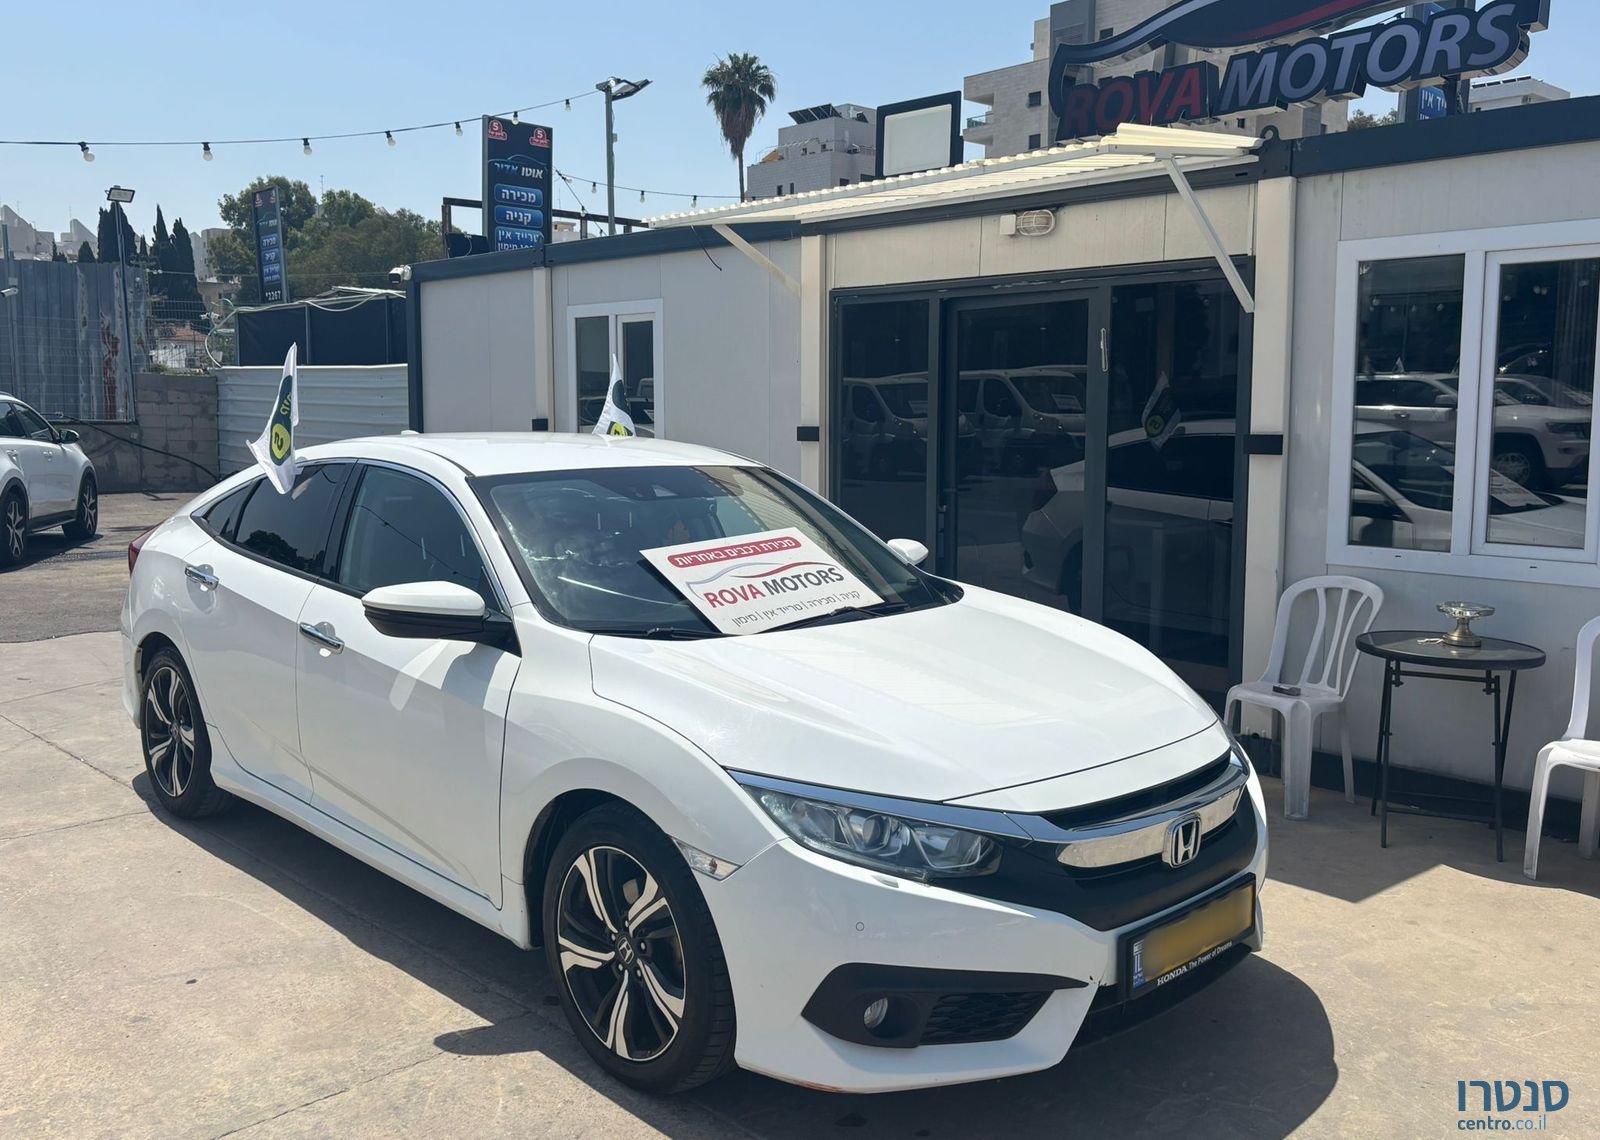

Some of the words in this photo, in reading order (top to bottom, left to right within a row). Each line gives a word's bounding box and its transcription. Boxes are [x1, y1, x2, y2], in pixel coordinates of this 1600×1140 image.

[1065, 68, 1201, 135] ROVA
[1219, 4, 1517, 111] MOTORS
[521, 166, 544, 179] אוטו
[501, 188, 536, 203] מכירה
[505, 210, 532, 225] קניה
[498, 230, 512, 241] אין
[724, 544, 761, 558] רכבים
[760, 539, 796, 552] מכירת
[675, 551, 727, 566] באחריות
[703, 583, 766, 609] ROVA
[762, 567, 845, 596] MOTORS
[807, 596, 837, 608] מכירה
[841, 590, 860, 602] קניה
[776, 602, 803, 615] טרייד
[731, 614, 758, 627] מימון
[1157, 966, 1187, 985] HONDA
[1188, 961, 1197, 970] The
[1198, 953, 1211, 964] Power
[1216, 941, 1232, 953] Dreams
